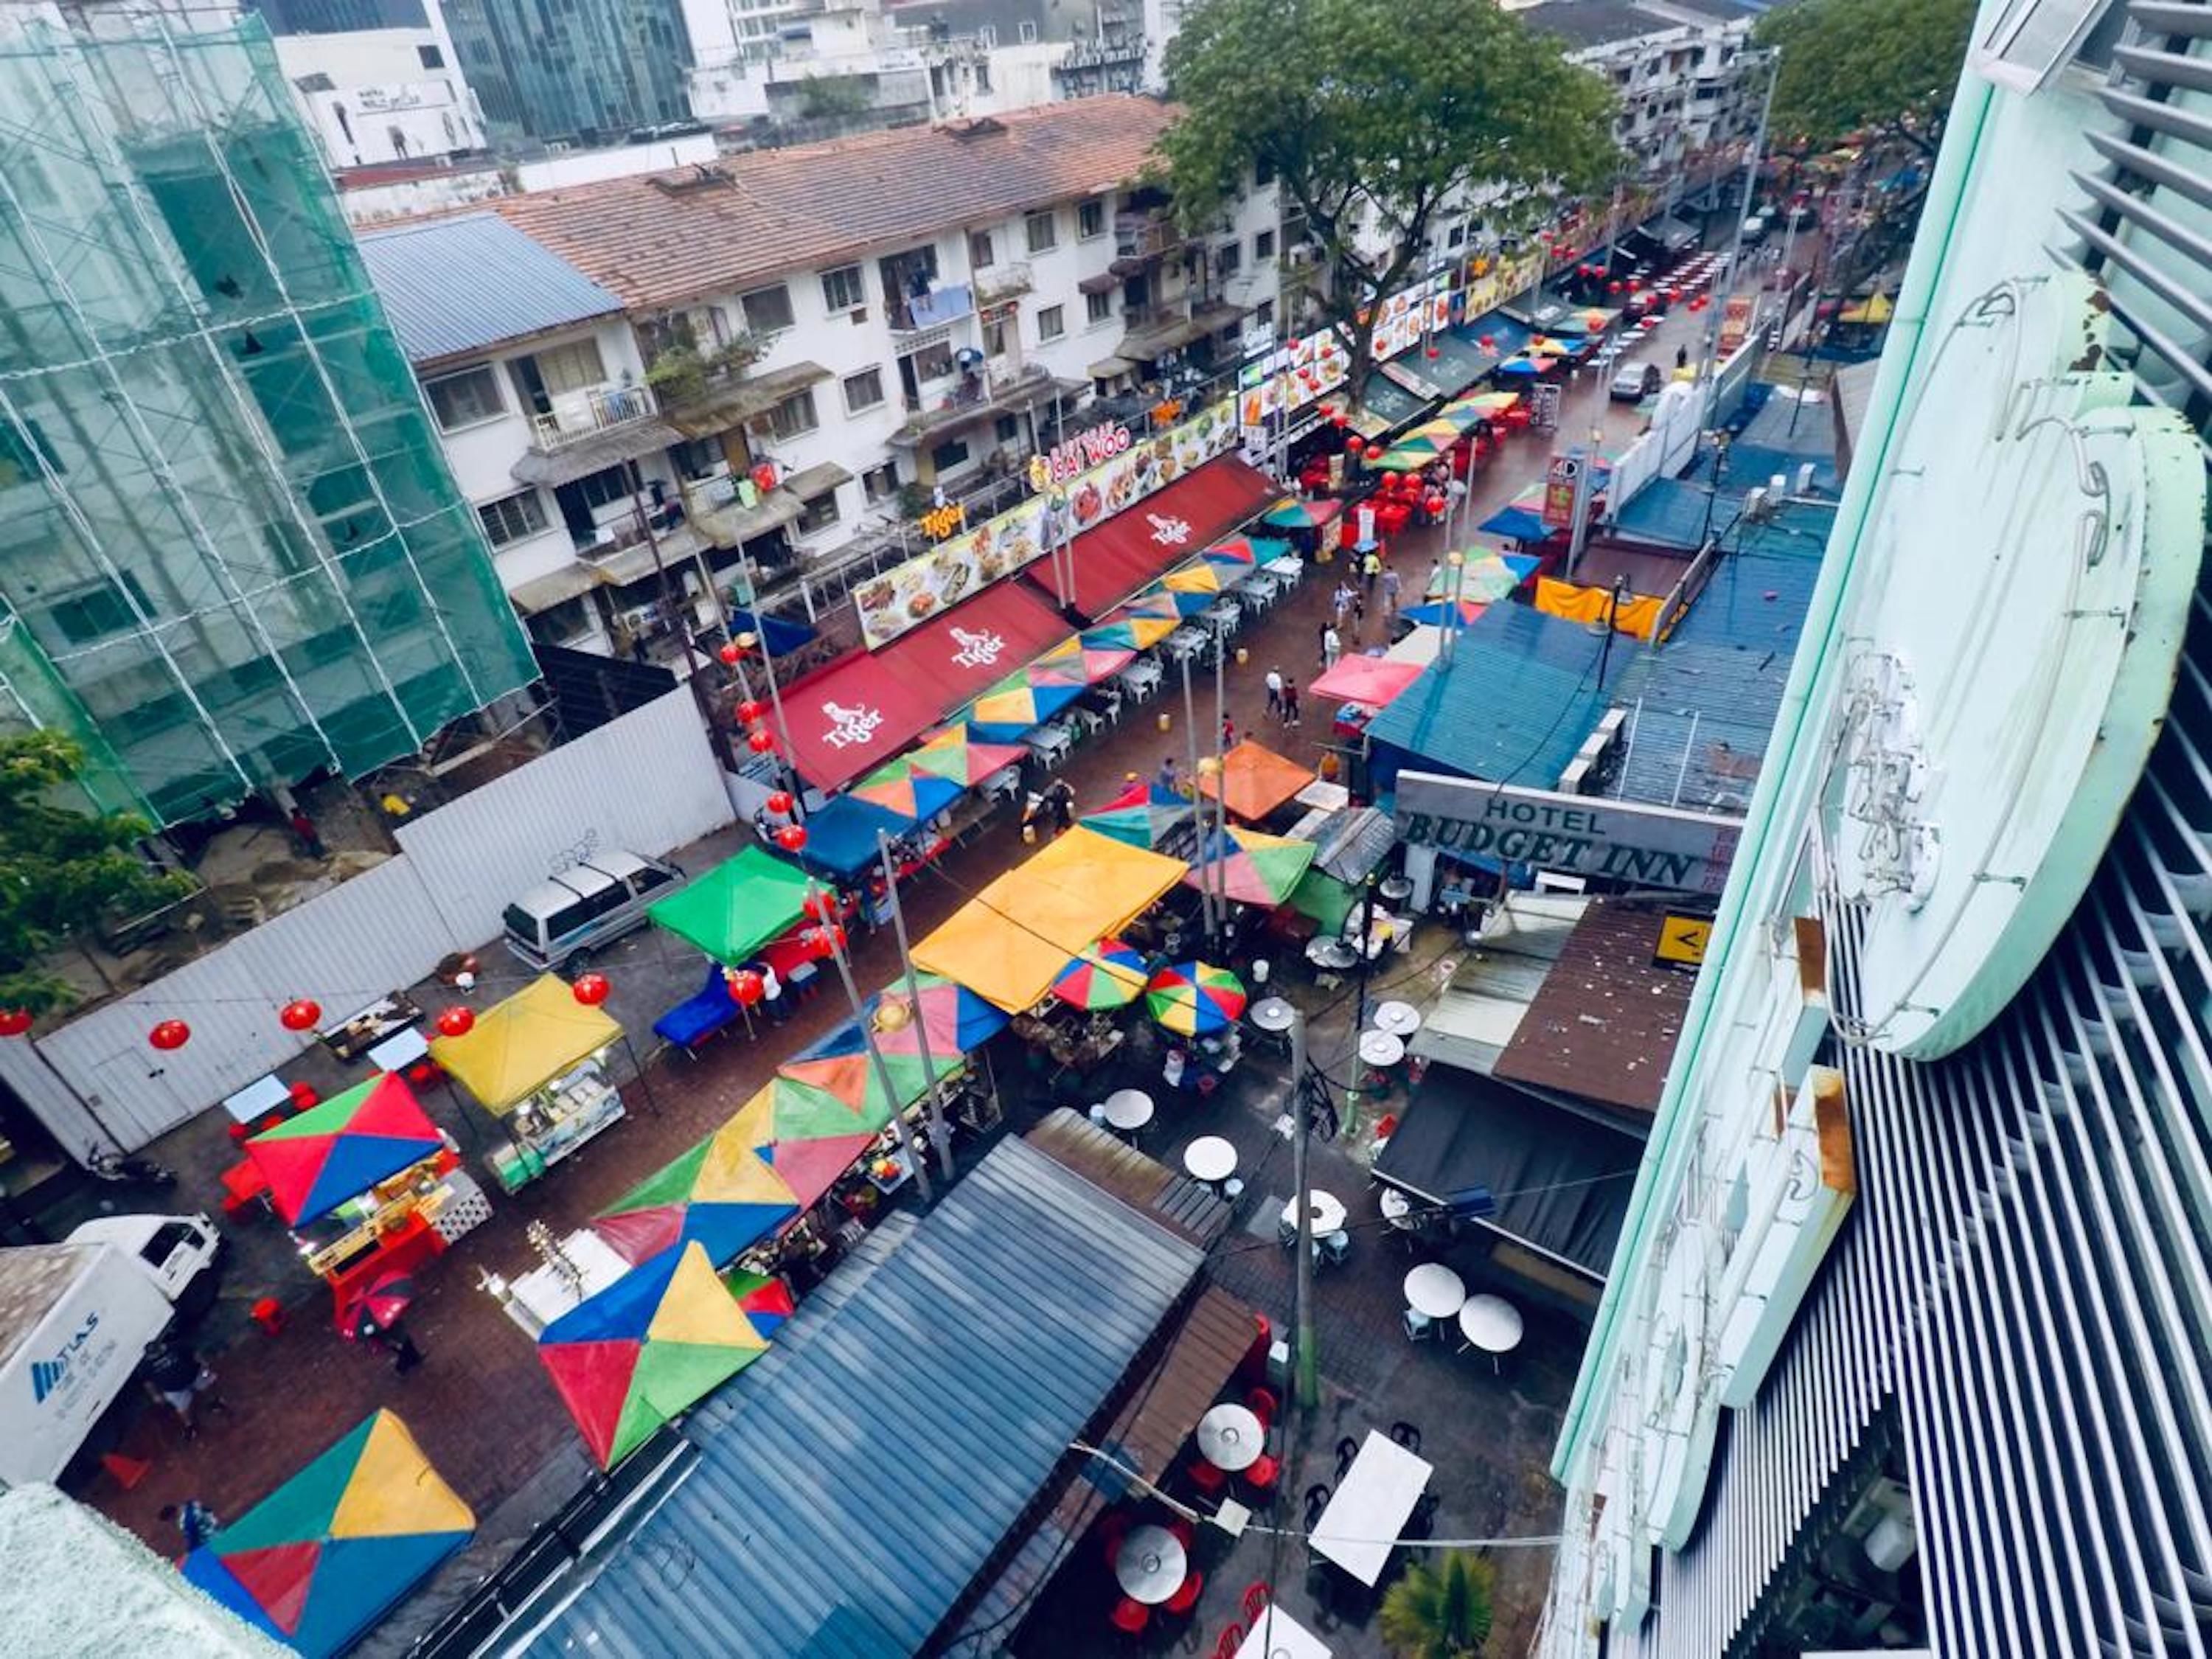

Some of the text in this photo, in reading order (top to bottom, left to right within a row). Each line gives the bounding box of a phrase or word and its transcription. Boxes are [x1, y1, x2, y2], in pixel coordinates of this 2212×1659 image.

[1085, 426, 1130, 466] WOO
[1552, 460, 1578, 479] 4D
[920, 504, 964, 538] Tiger
[951, 635, 1006, 669] Tiger
[821, 709, 885, 749] Tiger
[1486, 797, 1606, 835] HOTEL
[1405, 812, 1591, 868] BUDGET
[1599, 842, 1700, 886] INN
